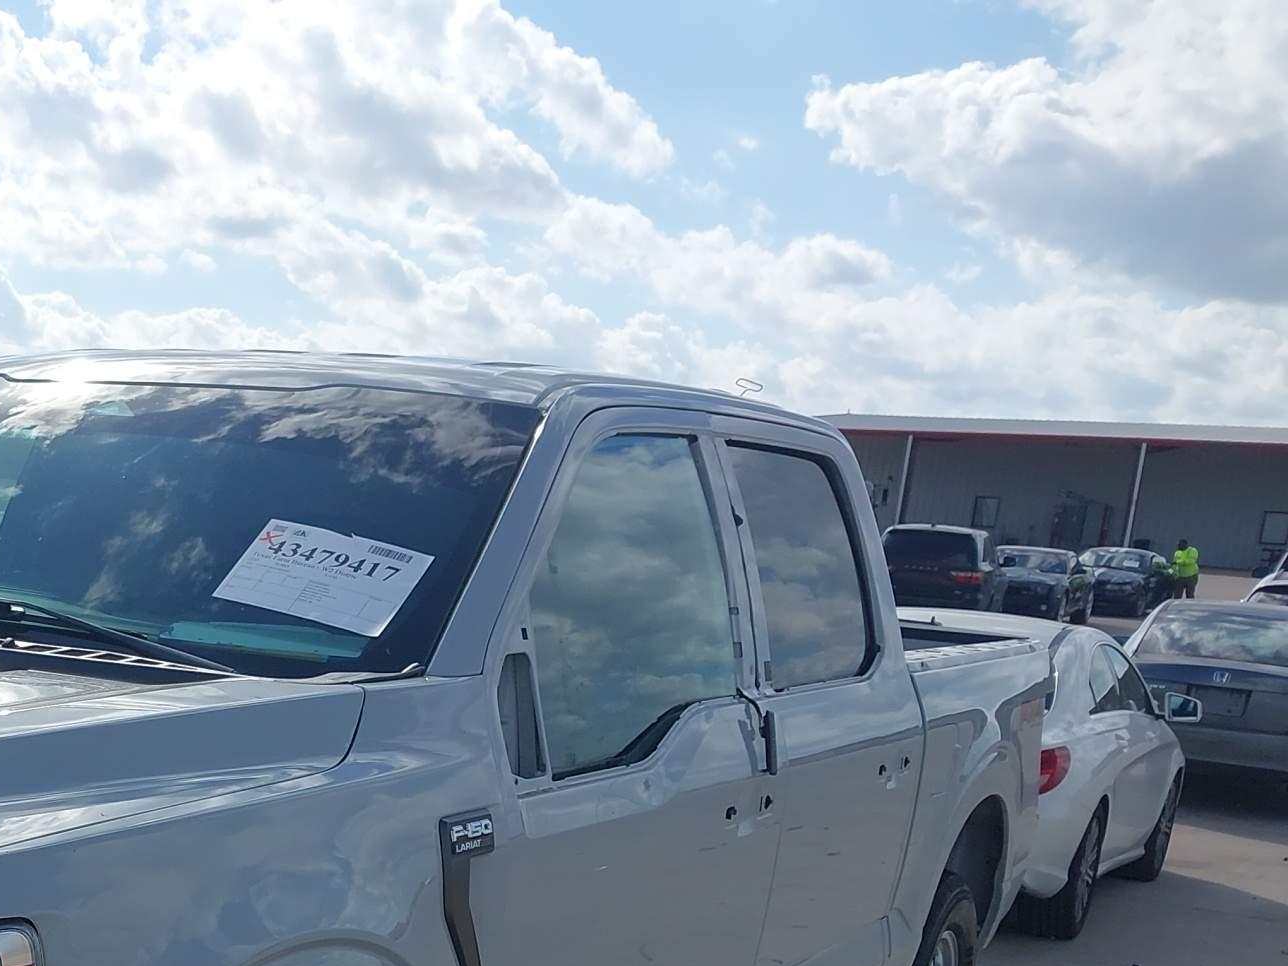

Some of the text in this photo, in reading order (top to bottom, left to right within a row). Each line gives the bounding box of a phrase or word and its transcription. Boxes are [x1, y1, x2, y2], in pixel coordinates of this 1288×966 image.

[268, 540, 402, 582] 43479417
[451, 818, 493, 842] F-150
[455, 839, 482, 853] LARIAT
